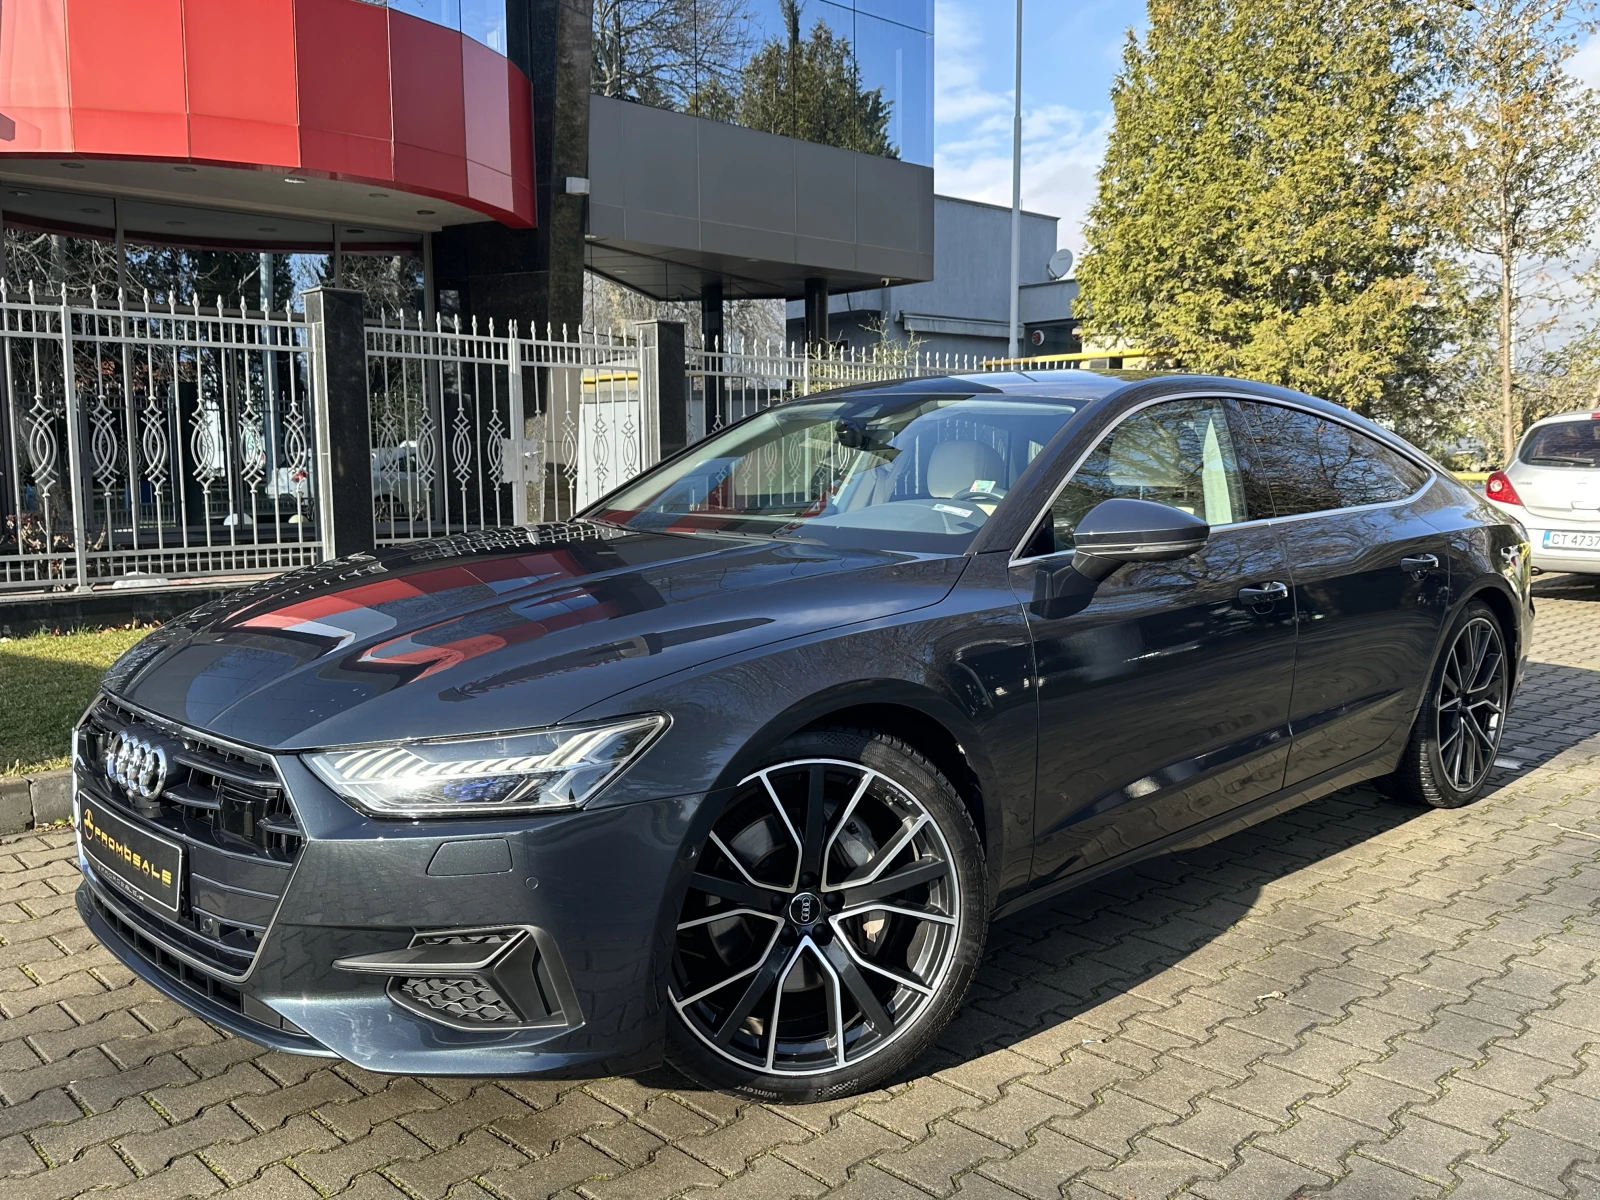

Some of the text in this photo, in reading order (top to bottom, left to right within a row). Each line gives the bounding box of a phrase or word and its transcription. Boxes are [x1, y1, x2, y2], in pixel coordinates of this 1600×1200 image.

[1552, 534, 1600, 547] CT 4737
[94, 826, 172, 885] PROMOSALE
